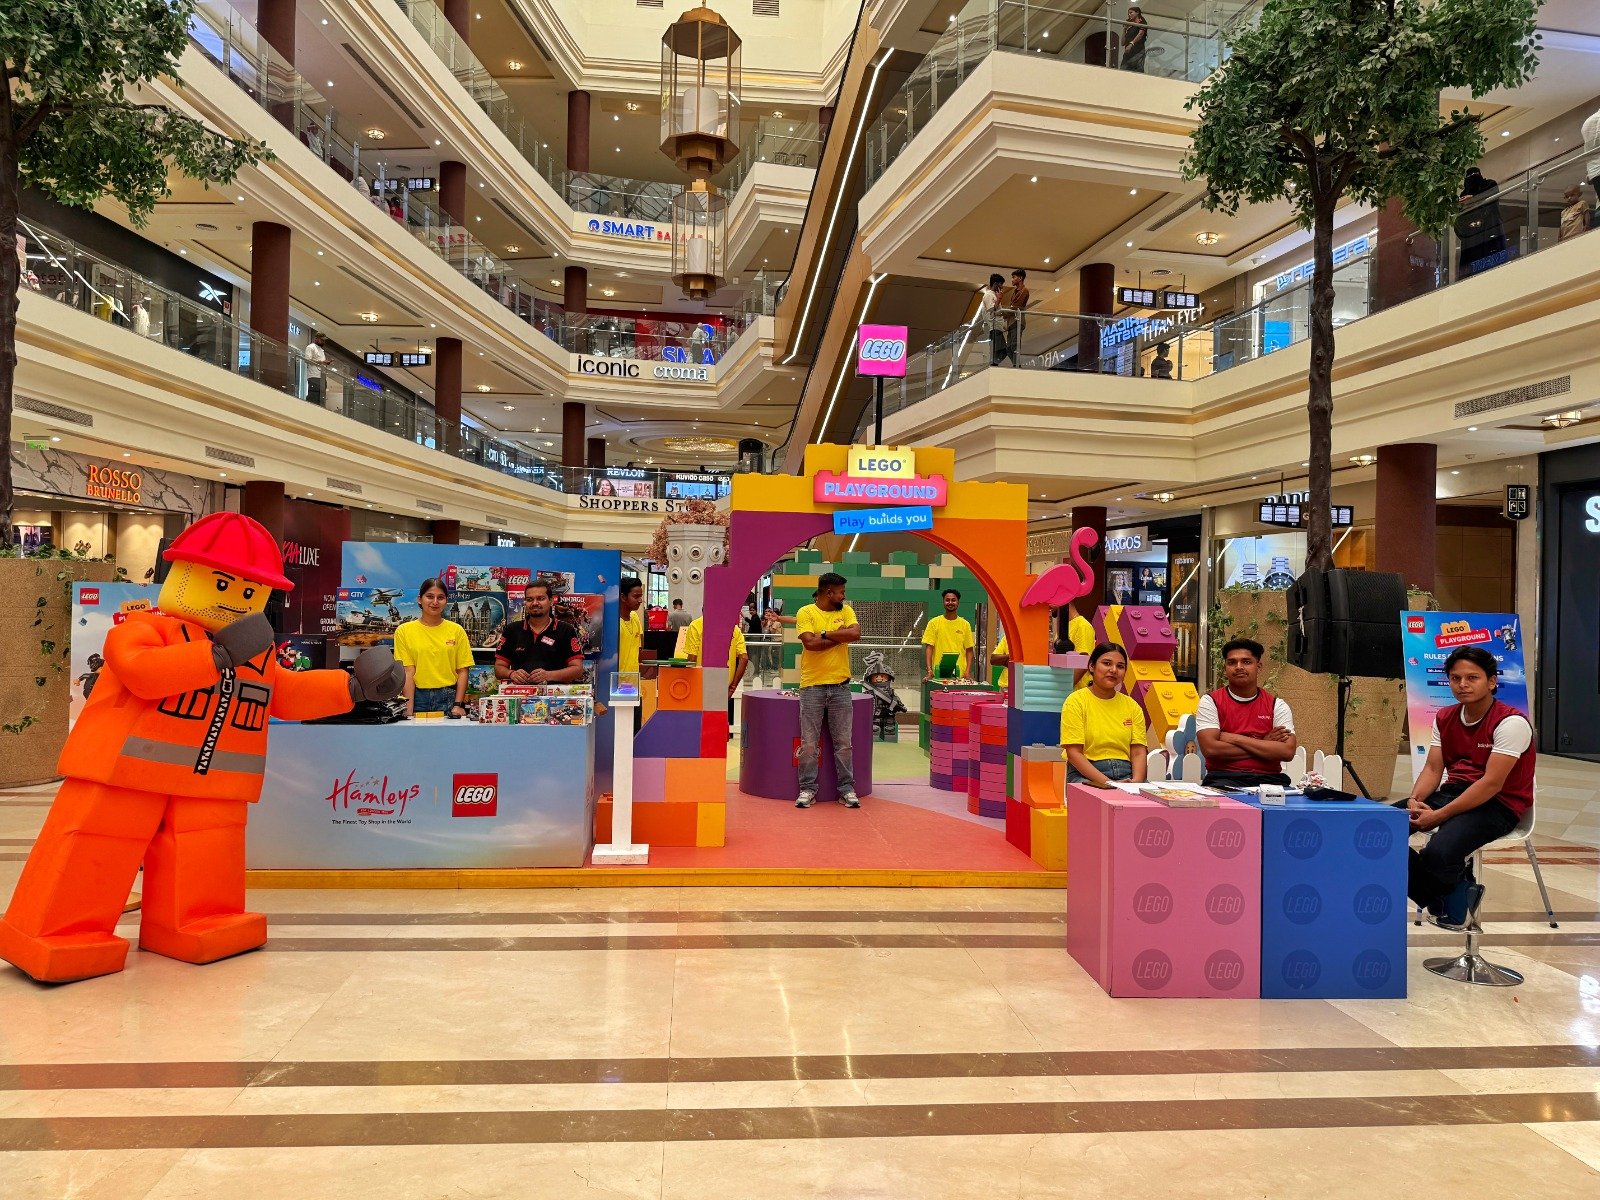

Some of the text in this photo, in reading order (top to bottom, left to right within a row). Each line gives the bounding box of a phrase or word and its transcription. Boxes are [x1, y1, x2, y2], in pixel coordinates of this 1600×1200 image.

[602, 220, 655, 239] SMART
[862, 340, 904, 360] LEGO
[577, 355, 640, 377] iconic
[606, 468, 645, 478] REVLON
[858, 459, 902, 472] LEGO
[88, 464, 141, 490] ROSSO
[87, 484, 141, 503] BRUNELLO
[824, 482, 938, 499] PLAYGROUND
[579, 496, 659, 512] SHOPPERS
[840, 512, 927, 529] Play builds you
[508, 576, 530, 585] LEGO
[81, 592, 98, 600] LEGO
[1446, 626, 1465, 634] LEGO
[1440, 633, 1486, 645] PLAYGROUND
[325, 768, 495, 817] Hamleys LEGO
[1138, 829, 1242, 848] LEGO LEGO
[1288, 831, 1389, 848] LEGO LEGO
[1137, 895, 1241, 913] LEGO LEGO
[1287, 896, 1388, 913] LEGO LEGO
[1136, 962, 1240, 979] LEGO LEGO
[1286, 961, 1387, 979] LEGO LEGO
